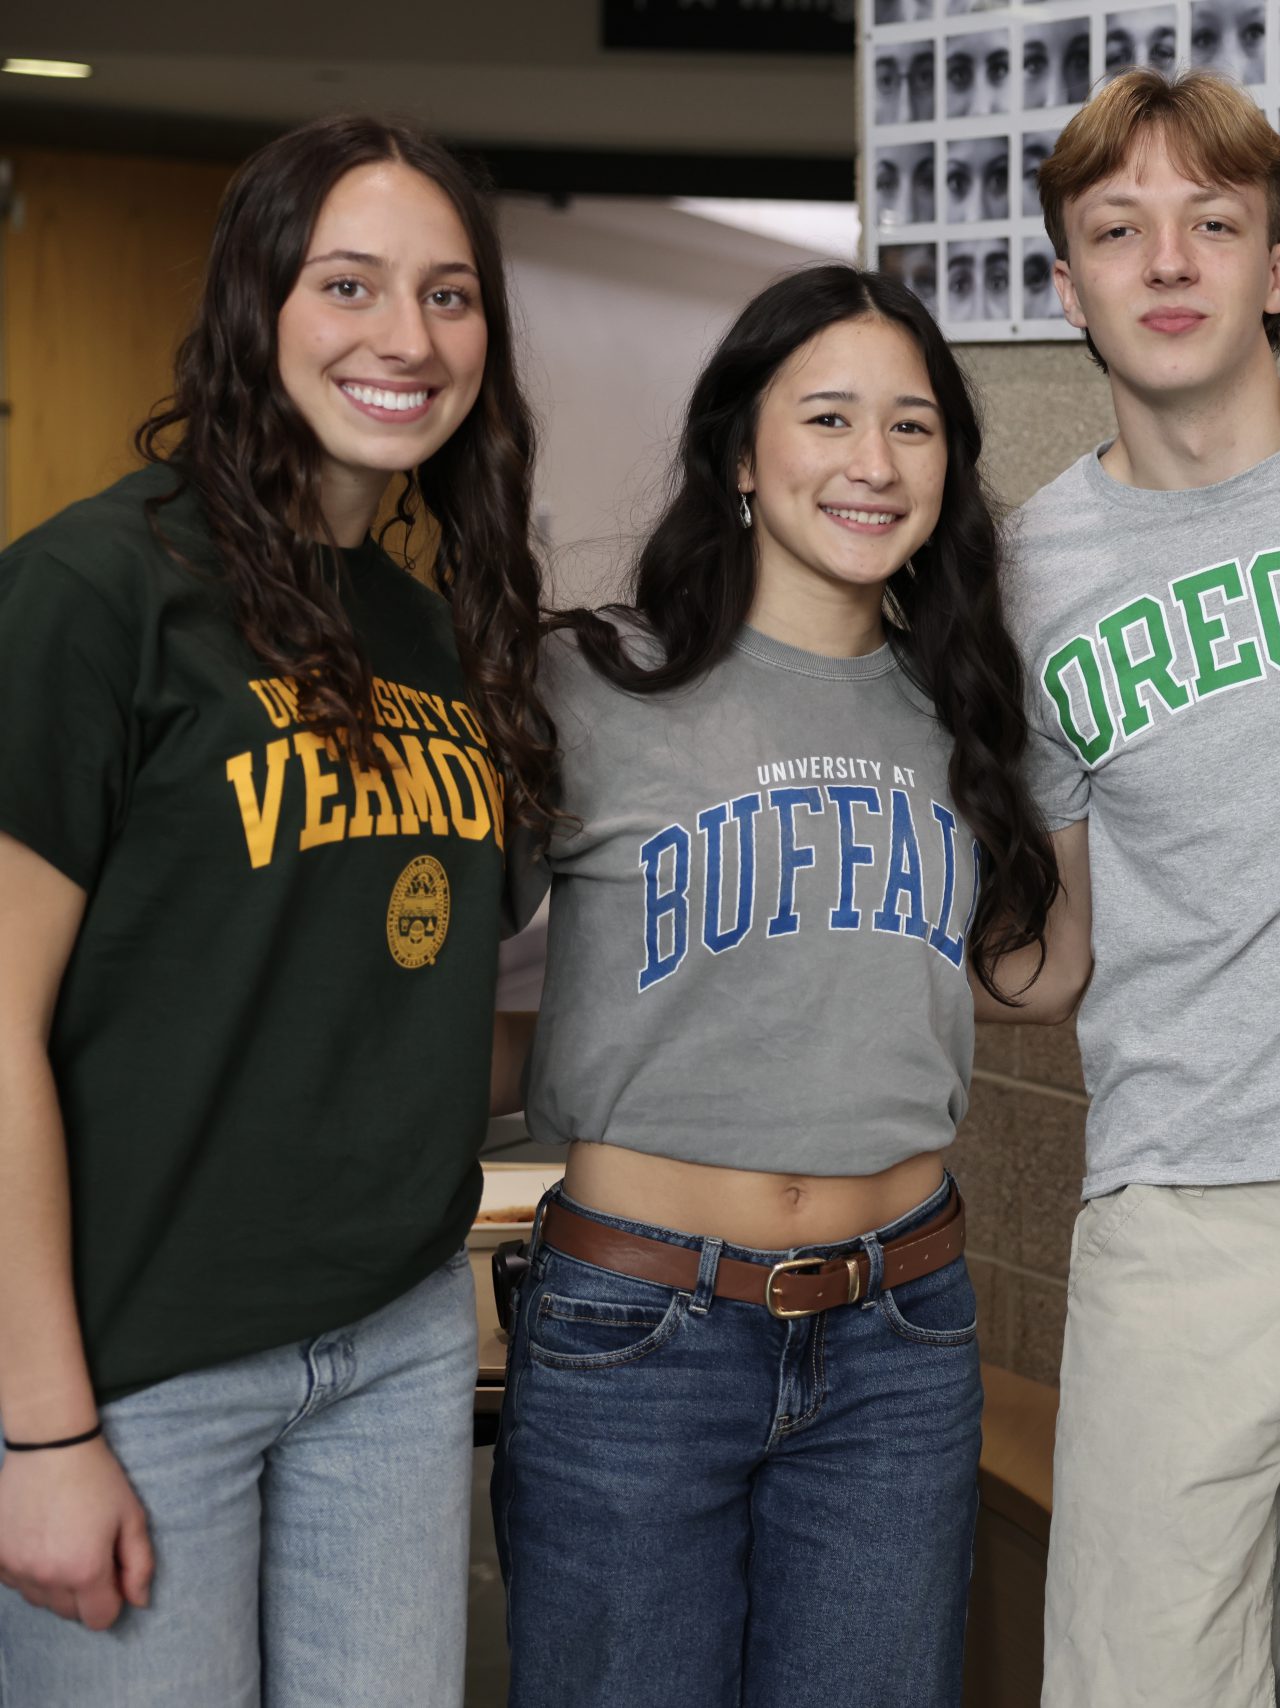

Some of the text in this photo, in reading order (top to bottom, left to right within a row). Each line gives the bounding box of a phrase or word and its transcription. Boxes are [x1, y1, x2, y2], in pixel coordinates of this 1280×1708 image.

[226, 730, 505, 870] VERMON
[757, 756, 916, 788] UNIVERSITY AT
[638, 784, 981, 994] BUFFAL
